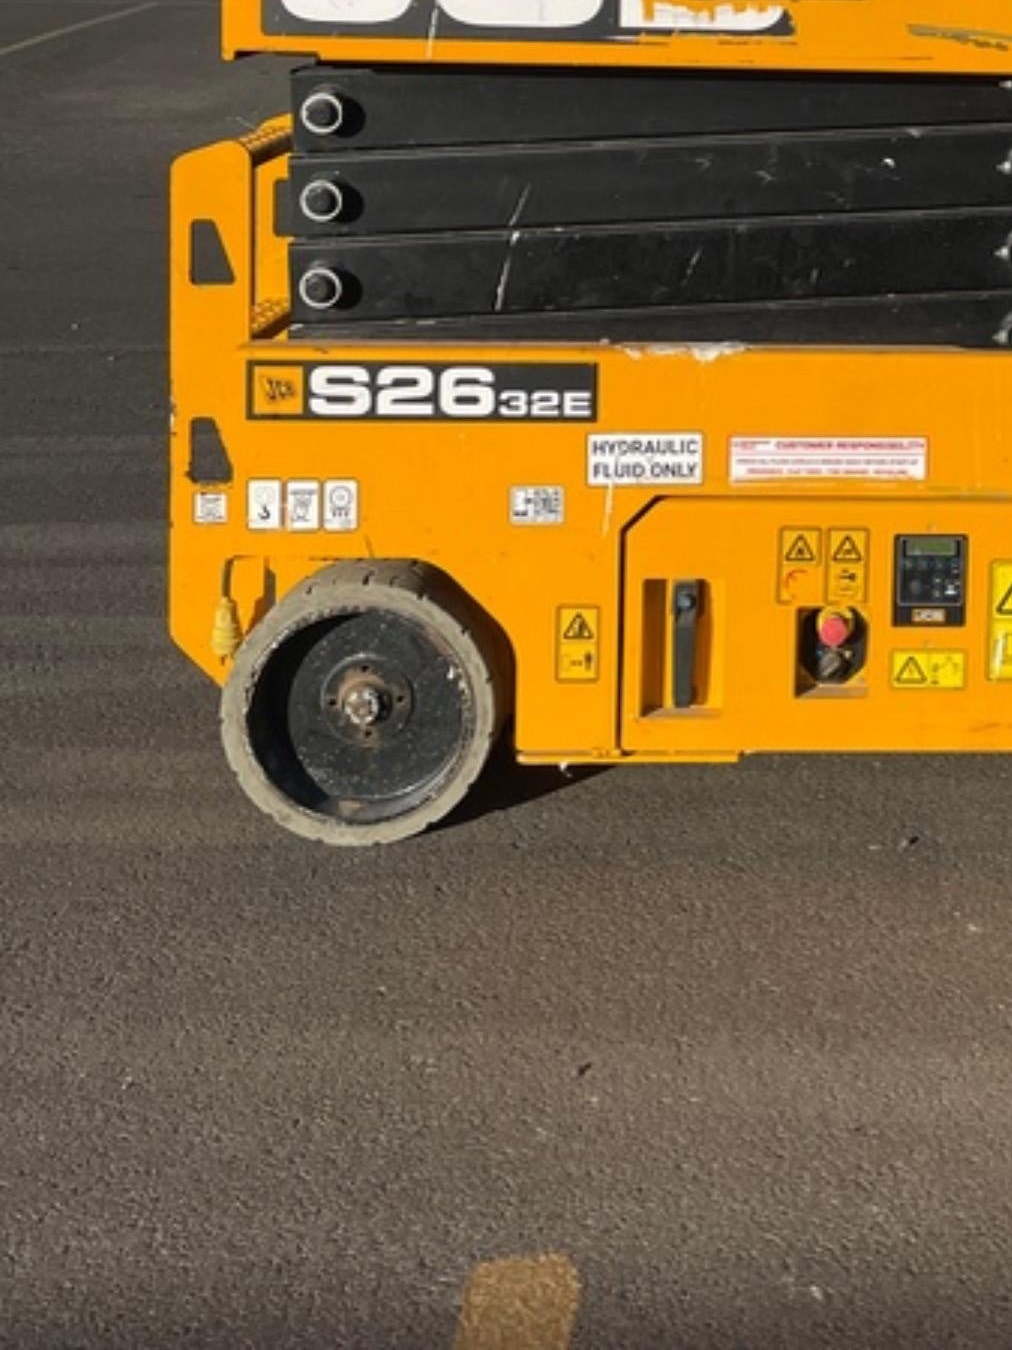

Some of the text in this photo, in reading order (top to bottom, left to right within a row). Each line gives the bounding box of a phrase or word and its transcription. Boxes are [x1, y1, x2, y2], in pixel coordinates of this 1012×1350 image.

[592, 439, 699, 455] HYDRAULIC
[593, 461, 698, 478] FLUID ONLY
